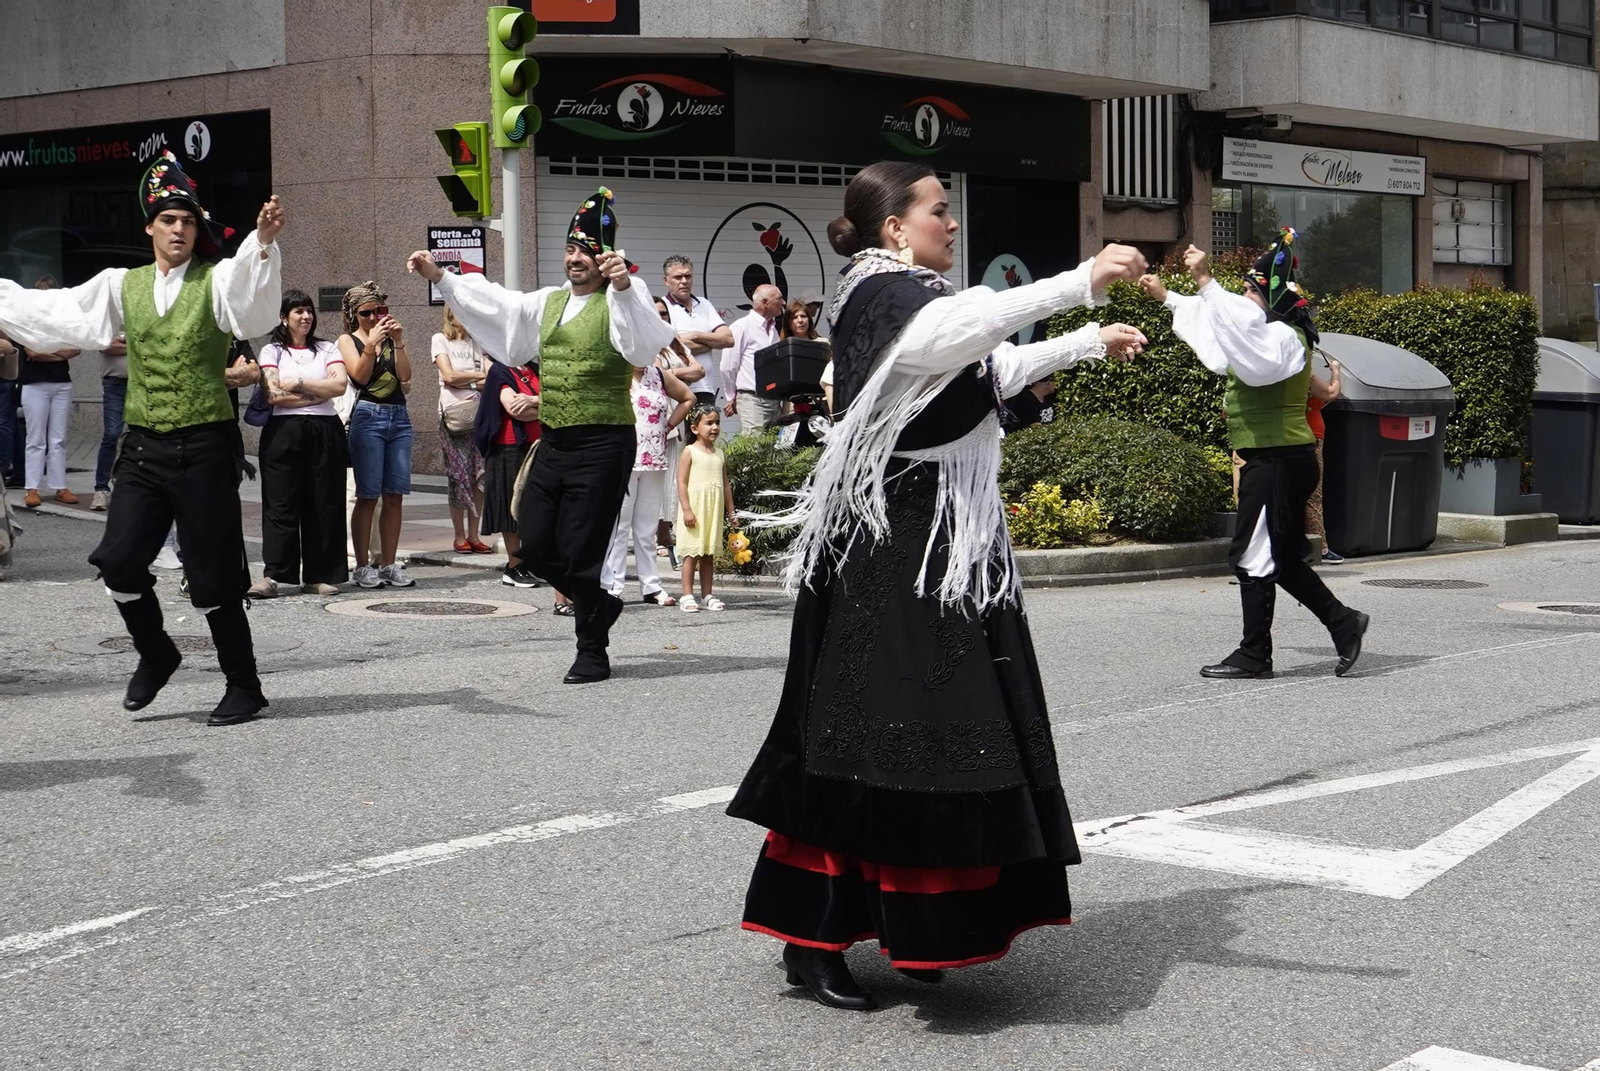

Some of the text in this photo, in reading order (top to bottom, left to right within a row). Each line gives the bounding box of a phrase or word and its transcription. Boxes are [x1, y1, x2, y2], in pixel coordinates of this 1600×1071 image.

[554, 98, 725, 116] Frutas Nieves
[881, 115, 972, 138] Frutas Nieves
[1321, 158, 1363, 187] Meloso
[1392, 180, 1421, 190] 607 804 712
[431, 230, 462, 239] Oferta
[437, 238, 481, 248] semana
[432, 249, 462, 261] SANDÍA
